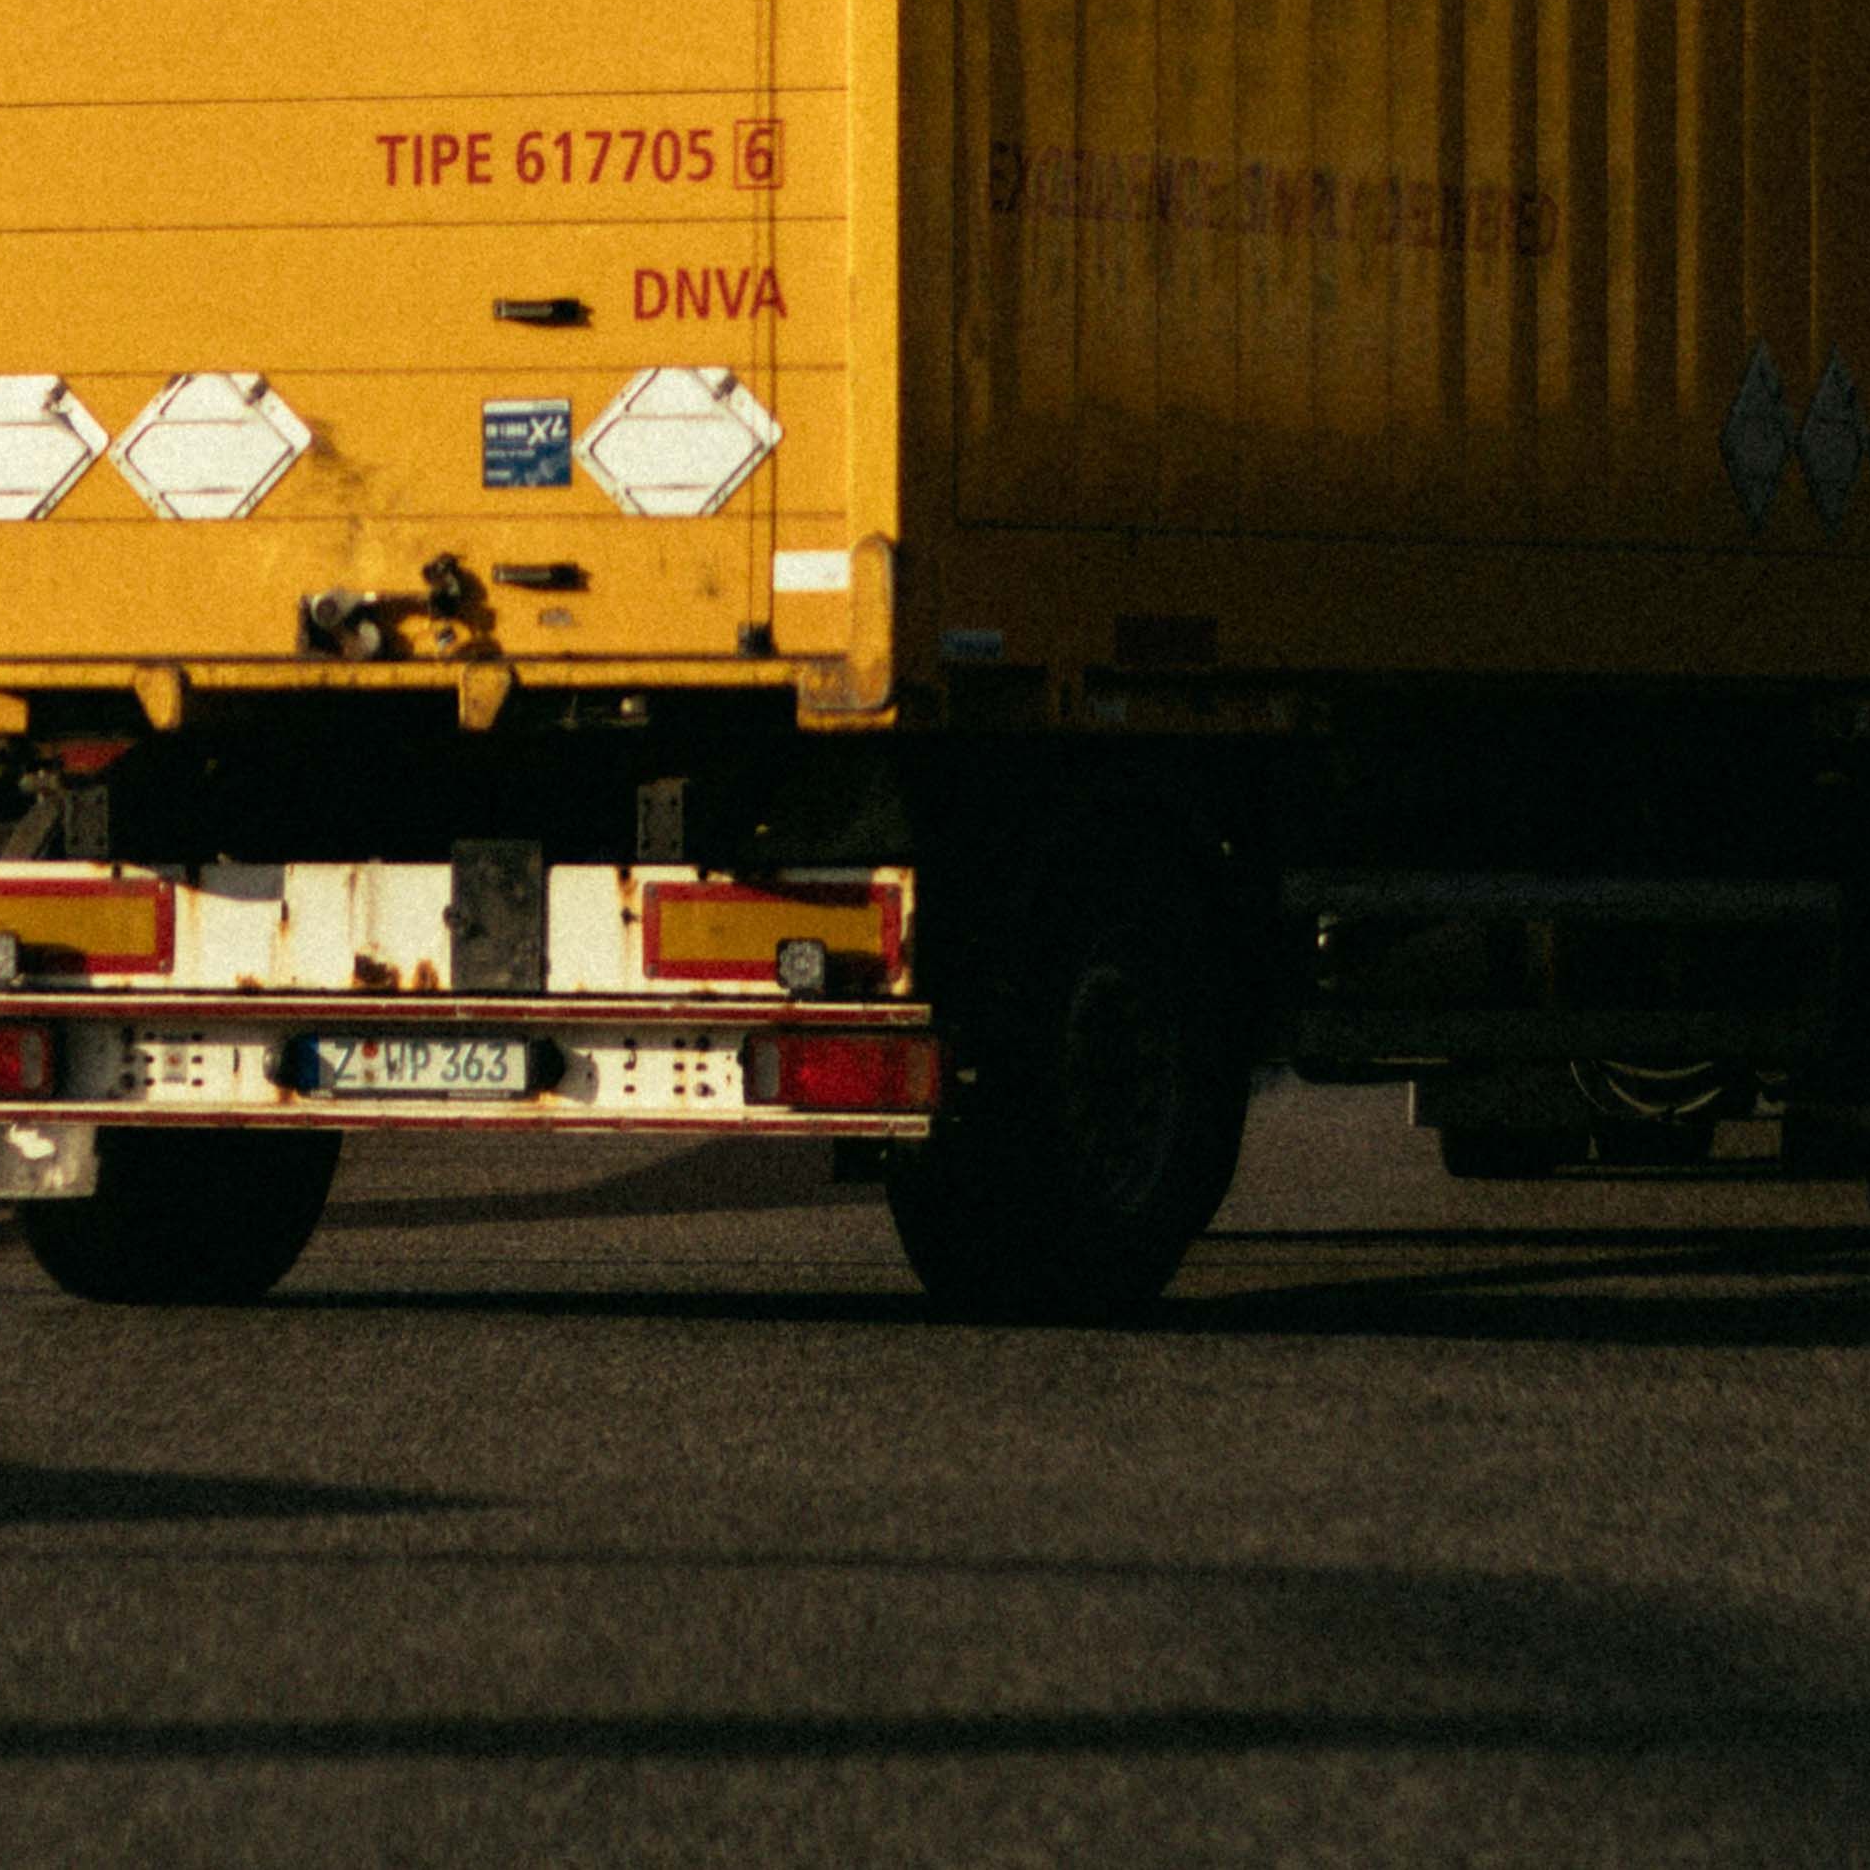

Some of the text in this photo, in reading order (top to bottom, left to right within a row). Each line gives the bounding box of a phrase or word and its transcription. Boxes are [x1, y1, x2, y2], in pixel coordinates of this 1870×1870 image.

[376, 128, 775, 186] TIPE 617705 6
[634, 267, 788, 320] DNVA
[528, 415, 568, 446] XL
[334, 1039, 508, 1082] Z WP 363
